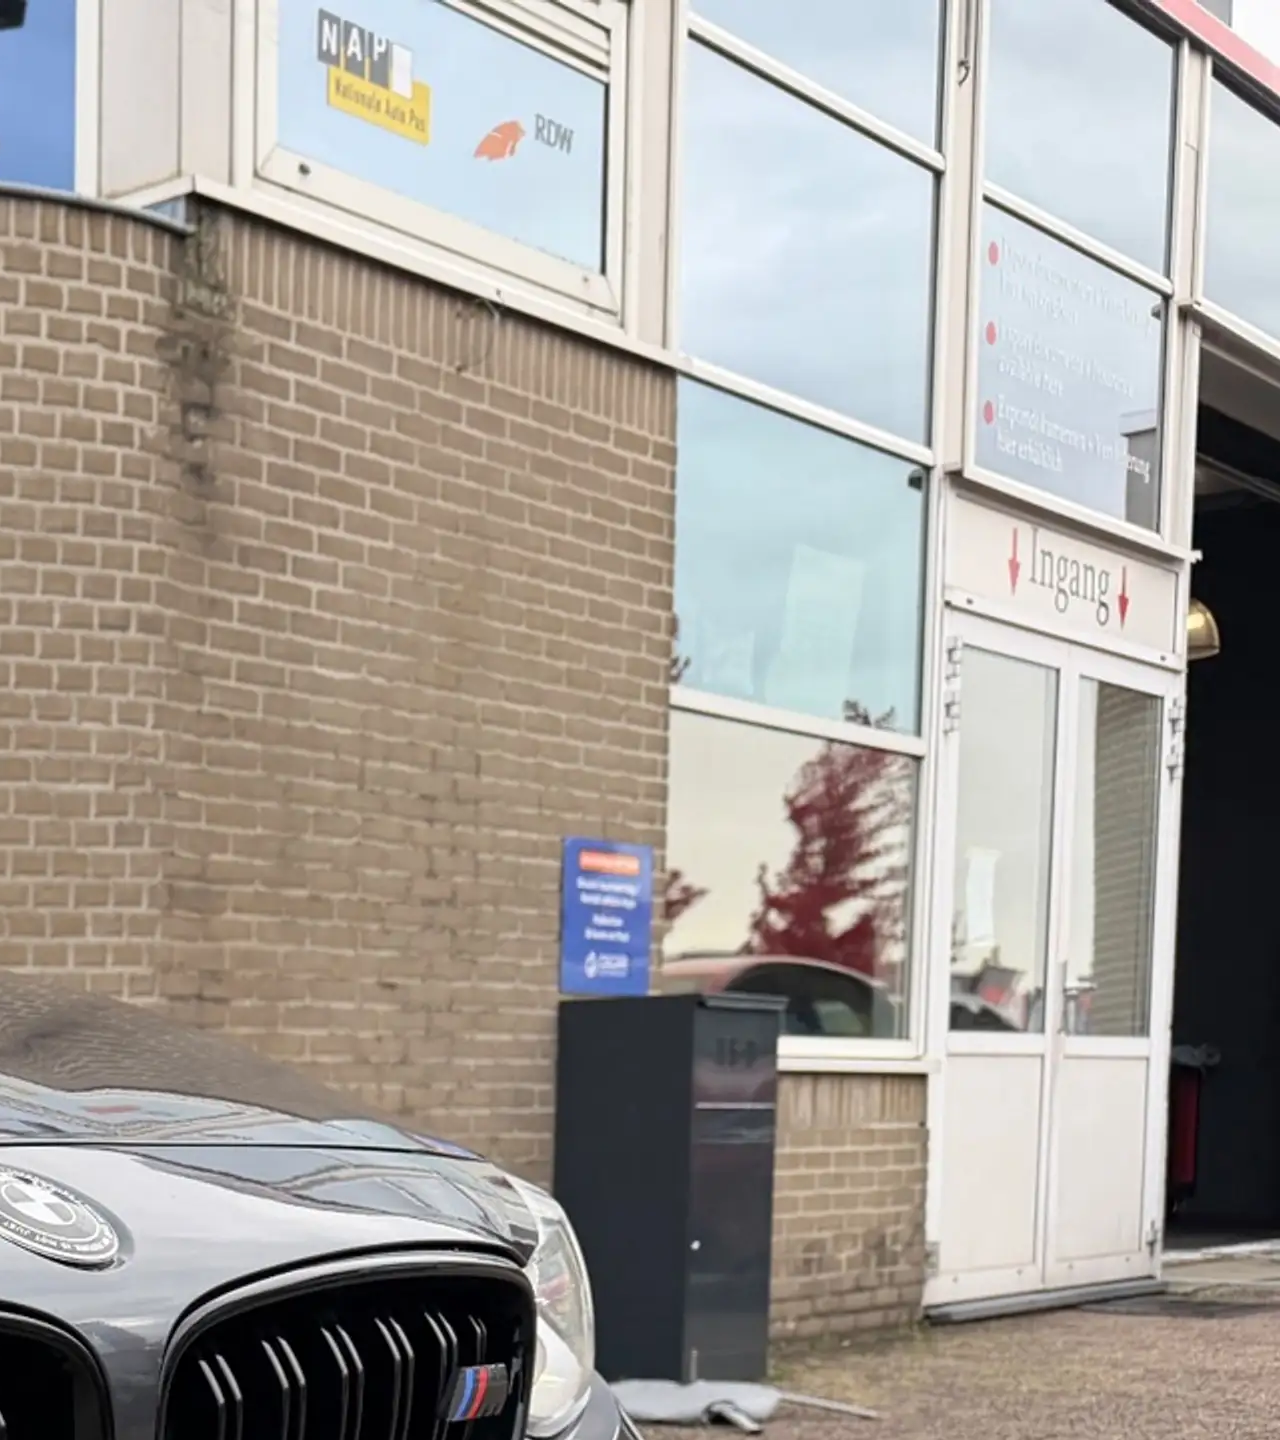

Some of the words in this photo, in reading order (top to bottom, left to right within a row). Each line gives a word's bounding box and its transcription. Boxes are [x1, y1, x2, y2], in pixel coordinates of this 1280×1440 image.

[322, 19, 387, 61] NAP
[534, 113, 575, 156] RDW
[1029, 526, 1111, 626] Ingang
